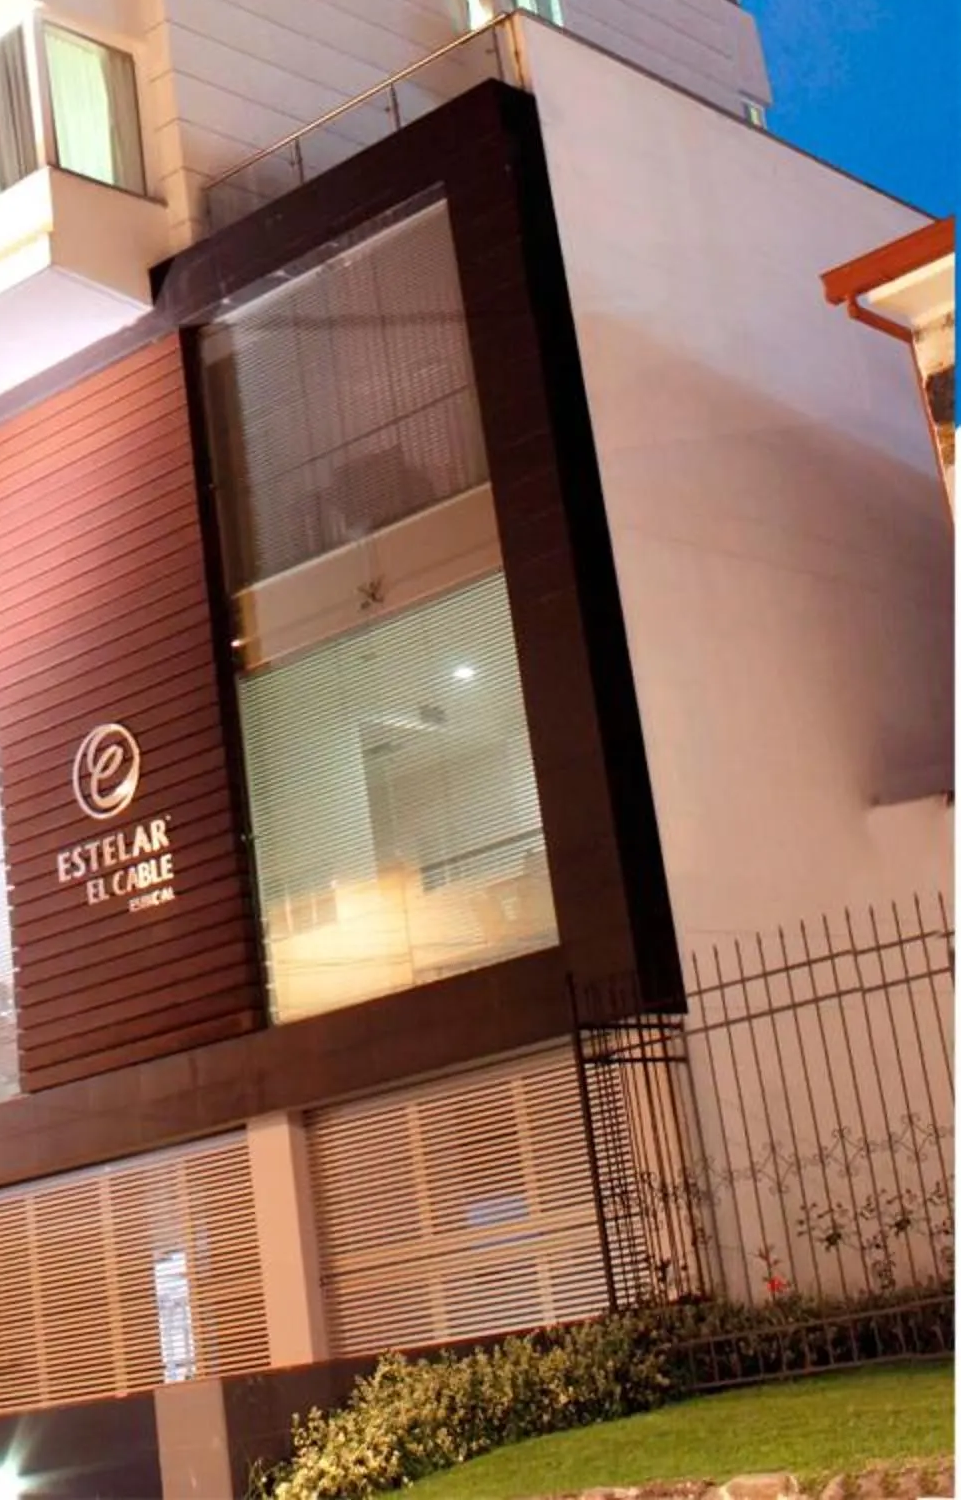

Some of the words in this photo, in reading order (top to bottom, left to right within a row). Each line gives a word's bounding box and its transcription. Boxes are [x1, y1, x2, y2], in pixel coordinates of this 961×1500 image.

[57, 819, 170, 883] ESTELAR
[86, 879, 110, 905] EL
[112, 853, 175, 897] CABLE
